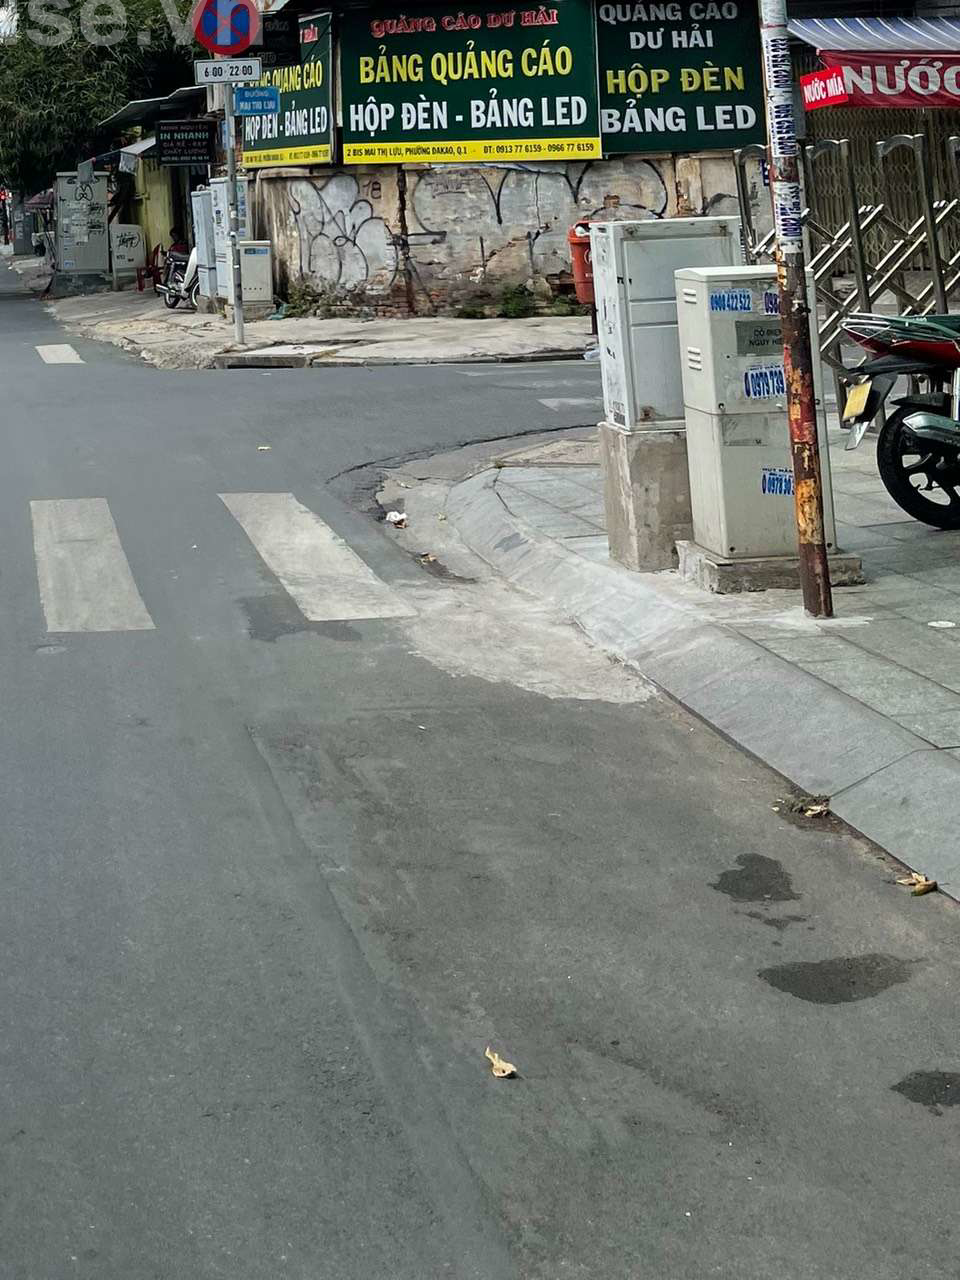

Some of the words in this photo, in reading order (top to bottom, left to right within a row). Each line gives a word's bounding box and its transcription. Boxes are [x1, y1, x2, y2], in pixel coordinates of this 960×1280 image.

[371, 14, 436, 38] QUẢNG
[442, 13, 481, 31] CÁO
[487, 11, 515, 28] DƯ
[521, 6, 559, 26] HẢI
[629, 27, 664, 49] DƯ
[672, 23, 714, 48] HẢI
[303, 54, 323, 88] CÁO
[359, 44, 424, 84] BẢNG
[431, 40, 513, 86] QUẢNG
[521, 39, 573, 77] CÁO
[606, 62, 670, 99] HỘP
[680, 61, 745, 92] ĐÈN
[842, 58, 960, 96] NƯỚC
[803, 77, 826, 104] NƯỚC
[826, 73, 845, 98] MÍA
[284, 100, 308, 137] BẢNG
[310, 106, 327, 133] LED
[349, 95, 395, 137] HỘP
[401, 94, 448, 130] ĐÈN
[470, 88, 534, 129] BẢNG
[542, 96, 587, 126] LED
[600, 98, 687, 134] BẢNG
[696, 104, 757, 131] LED
[515, 144, 523, 153] 77
[566, 143, 575, 152] 77
